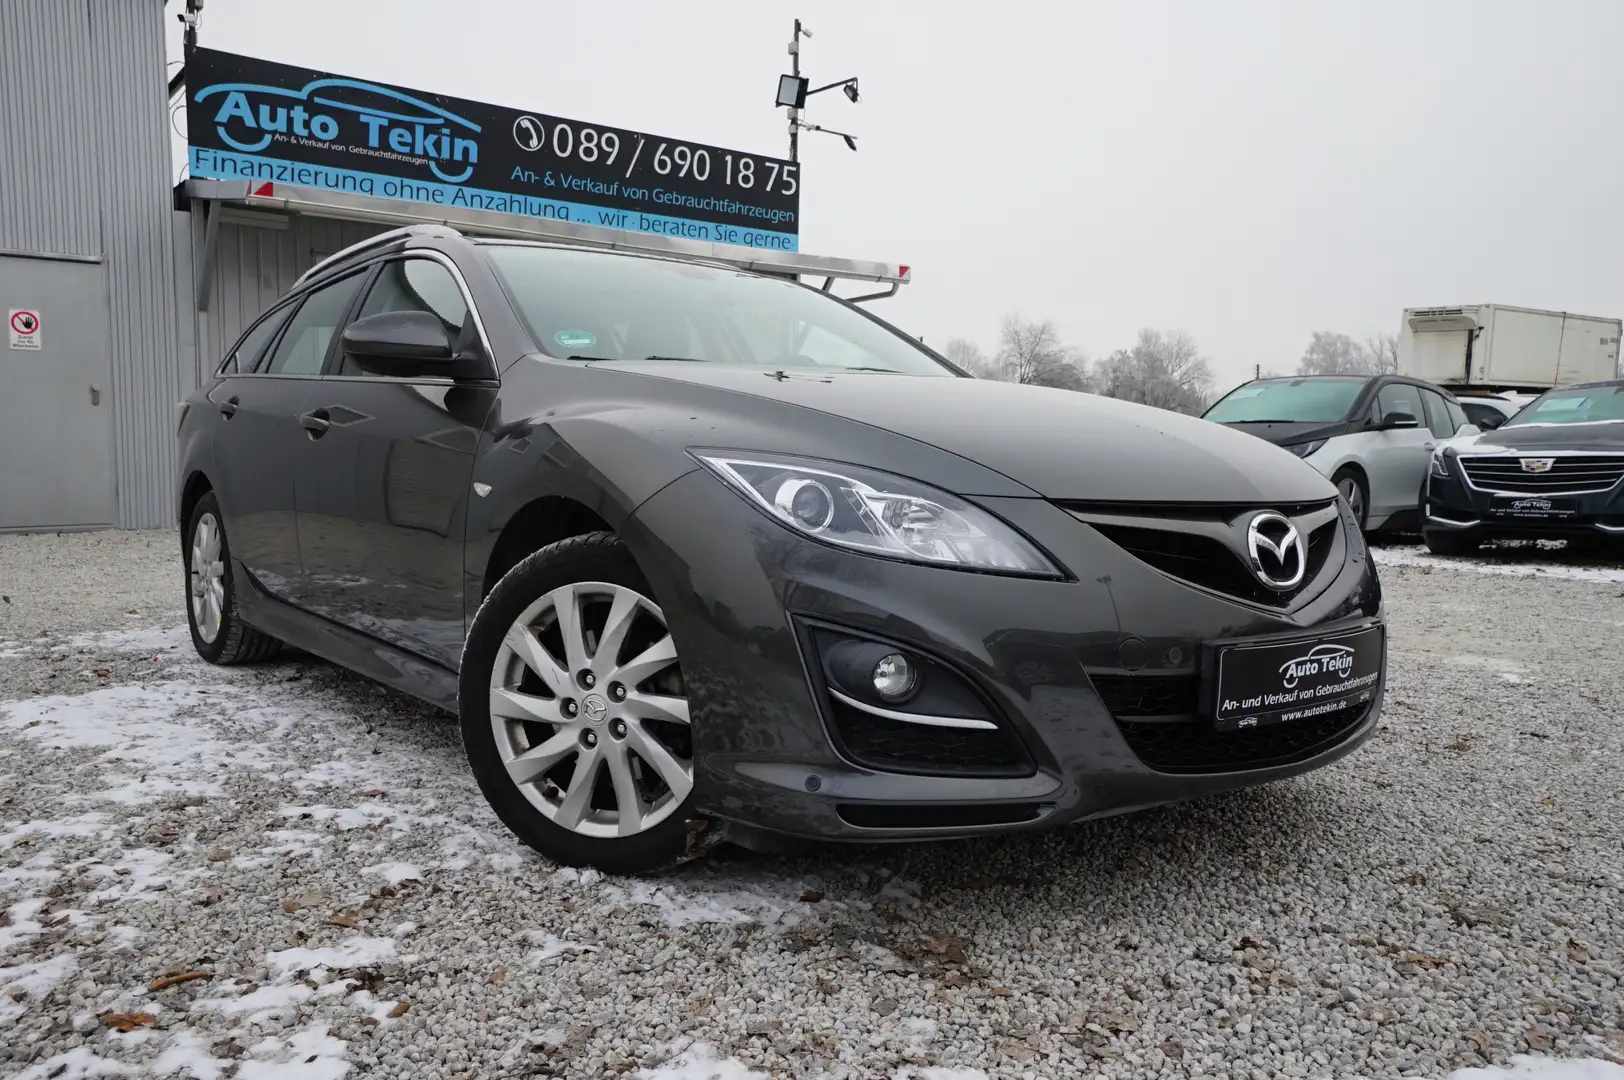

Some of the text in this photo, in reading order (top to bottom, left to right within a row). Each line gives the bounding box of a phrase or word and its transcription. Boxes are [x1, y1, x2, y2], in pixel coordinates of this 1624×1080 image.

[214, 91, 478, 163] Auto Tekin
[274, 134, 428, 166] An- & Verkauf von Gebrauchtfahrzeugen
[553, 124, 798, 195] 089 / 690 18 75
[195, 148, 374, 196] Finanzierung
[383, 179, 444, 204] ohne
[451, 187, 570, 221] Anzahlung
[598, 210, 628, 227] wir
[639, 214, 709, 240] beraten
[714, 224, 739, 244] Sie
[743, 232, 792, 250] gerne
[511, 165, 795, 224] An- & Verkauf von Gebrauchtfahrzeugen
[1222, 671, 1378, 711] An- und Verkauf von Gebrauchtfahrzeugen
[1285, 655, 1353, 679] Auto Tekin
[1281, 700, 1347, 722] www.autotekin.de
